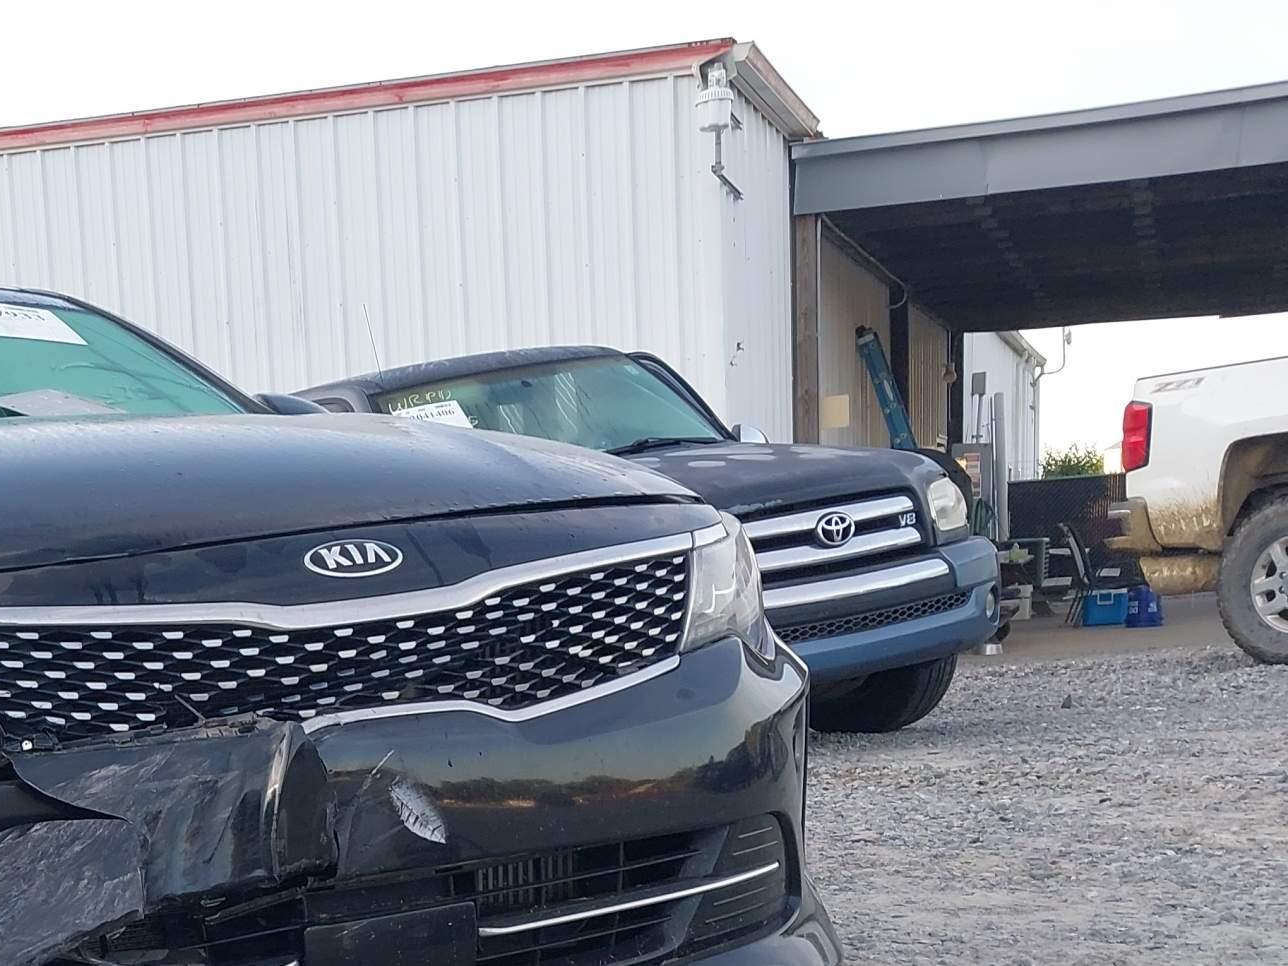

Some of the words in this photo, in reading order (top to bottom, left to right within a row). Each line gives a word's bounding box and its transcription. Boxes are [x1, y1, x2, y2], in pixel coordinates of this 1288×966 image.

[1150, 377, 1206, 394] Z71
[898, 512, 917, 527] V8
[318, 542, 392, 570] KIA
